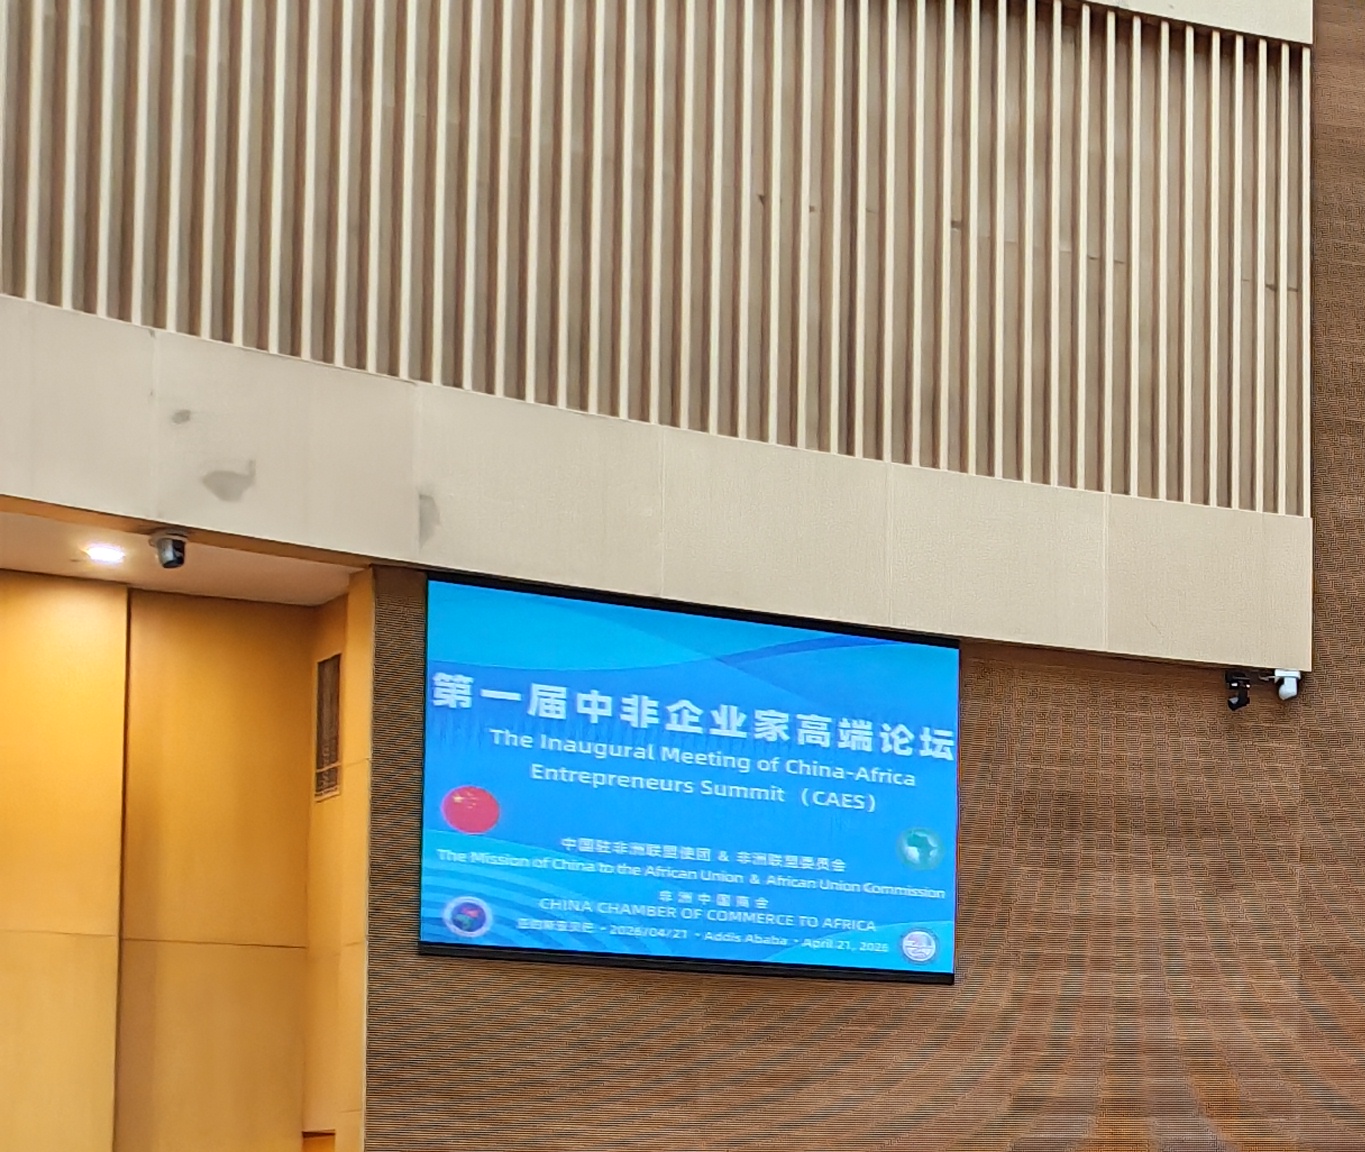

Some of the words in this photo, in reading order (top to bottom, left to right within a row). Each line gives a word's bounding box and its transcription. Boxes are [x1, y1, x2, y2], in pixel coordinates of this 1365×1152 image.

[432, 672, 955, 761] 第一届中非企业家高端论坛
[489, 728, 533, 749] The
[541, 733, 655, 761] Inaugural
[661, 746, 750, 774] Meeting
[757, 757, 780, 773] of
[785, 759, 916, 787] China-Africa
[531, 763, 694, 794] Entrepreneurs
[701, 780, 785, 802] Summit
[437, 848, 466, 862] The
[470, 851, 530, 867] Mission
[533, 857, 550, 868] of
[552, 858, 595, 872] China
[599, 862, 614, 874] to
[617, 863, 641, 876] the
[645, 865, 697, 880] African
[700, 870, 744, 884] Union
[749, 874, 760, 885] &
[766, 874, 817, 889] African
[819, 879, 861, 893] Union
[863, 882, 946, 899] Commission
[717, 850, 729, 863] &
[539, 898, 593, 913] CHINA
[597, 901, 676, 919] CHAMBER
[681, 906, 702, 920] OF
[707, 909, 794, 926] COMMERCE
[798, 915, 819, 928] TO
[822, 917, 876, 931] AFRICA
[703, 931, 742, 943] Addis
[745, 933, 787, 946] Ababa
